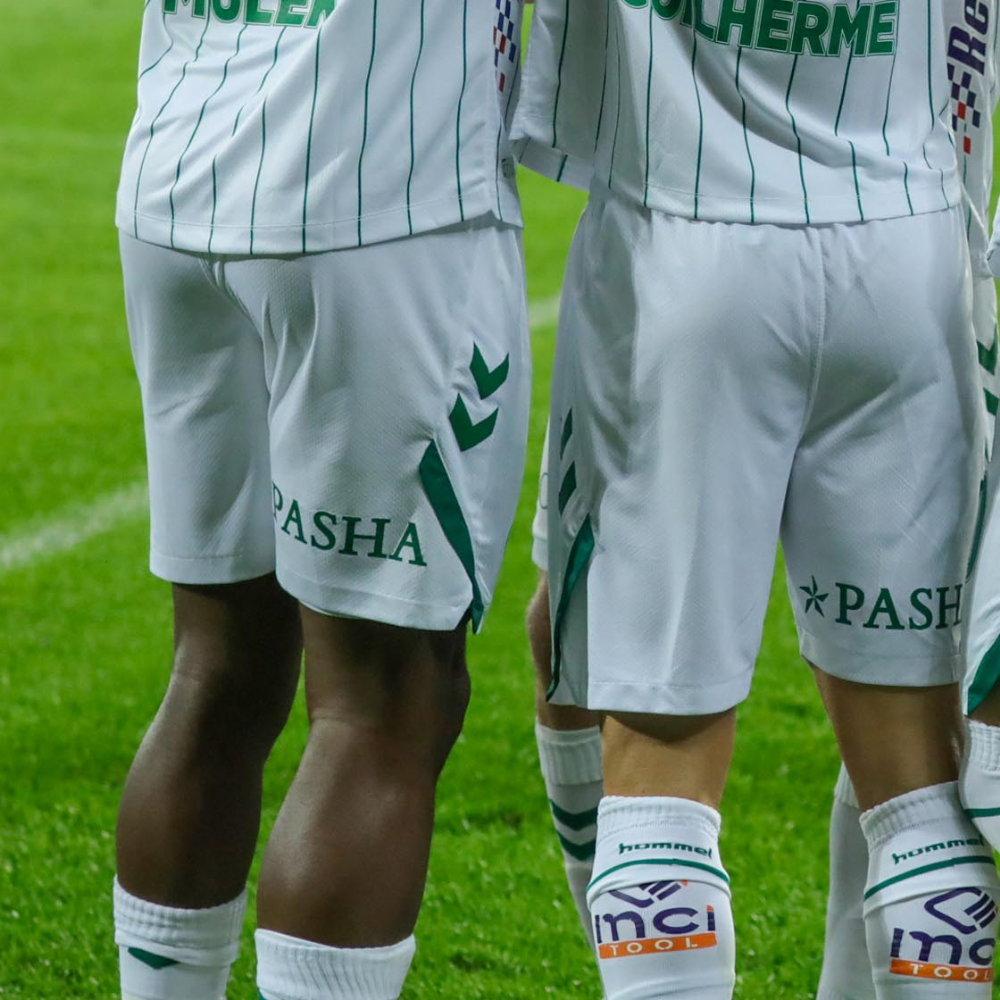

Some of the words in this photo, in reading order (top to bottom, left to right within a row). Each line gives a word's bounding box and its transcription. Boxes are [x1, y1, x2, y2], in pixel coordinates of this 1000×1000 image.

[271, 480, 428, 567] PASHA
[618, 842, 713, 860] hummel
[609, 937, 698, 956] TOOL
